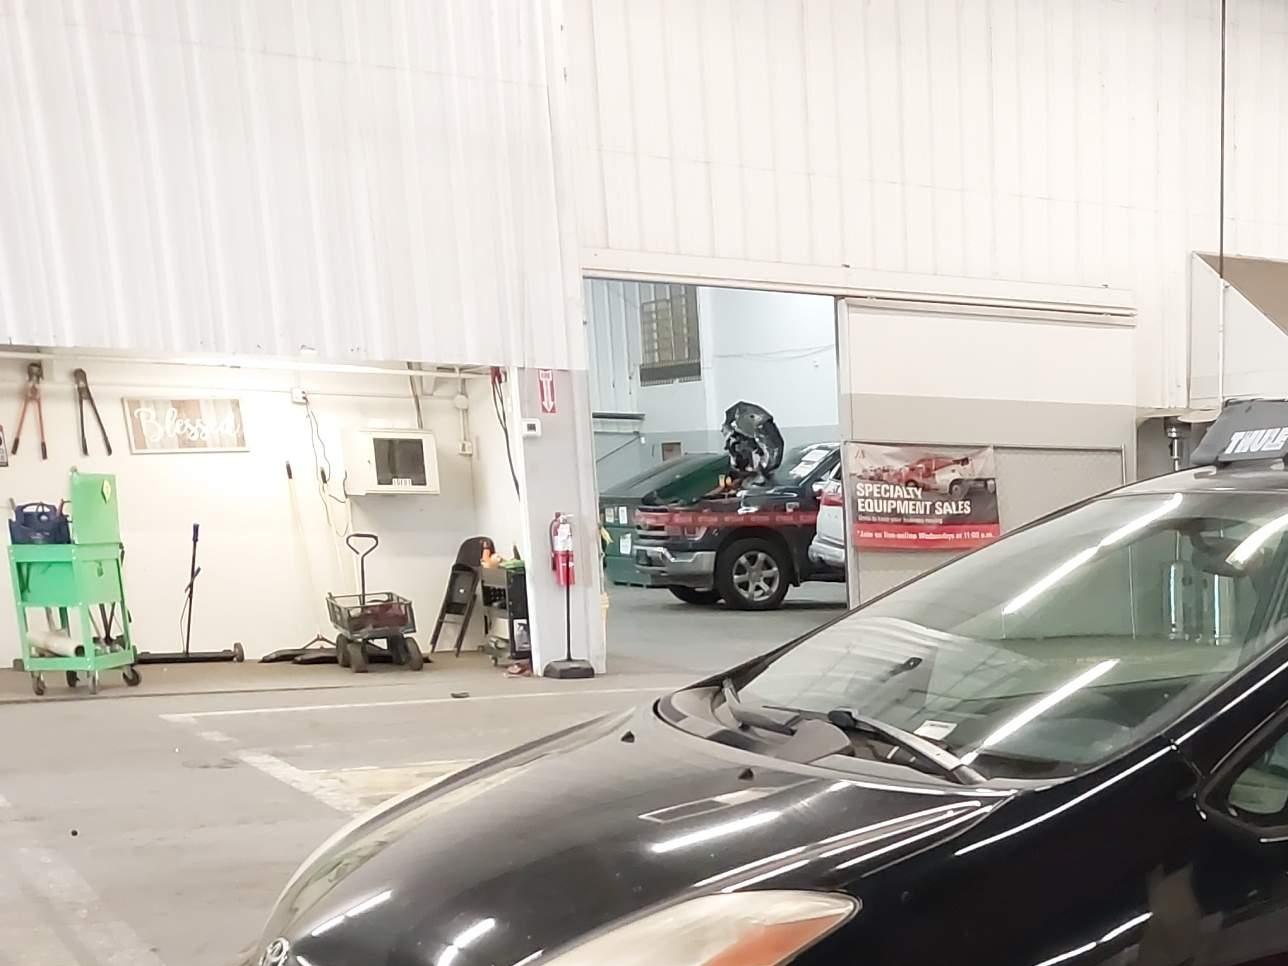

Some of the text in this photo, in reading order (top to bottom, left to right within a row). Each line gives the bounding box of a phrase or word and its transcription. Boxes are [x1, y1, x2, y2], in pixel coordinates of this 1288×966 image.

[856, 483, 923, 499] SPECIALTY
[857, 498, 972, 515] EQUIPMENT SALES
